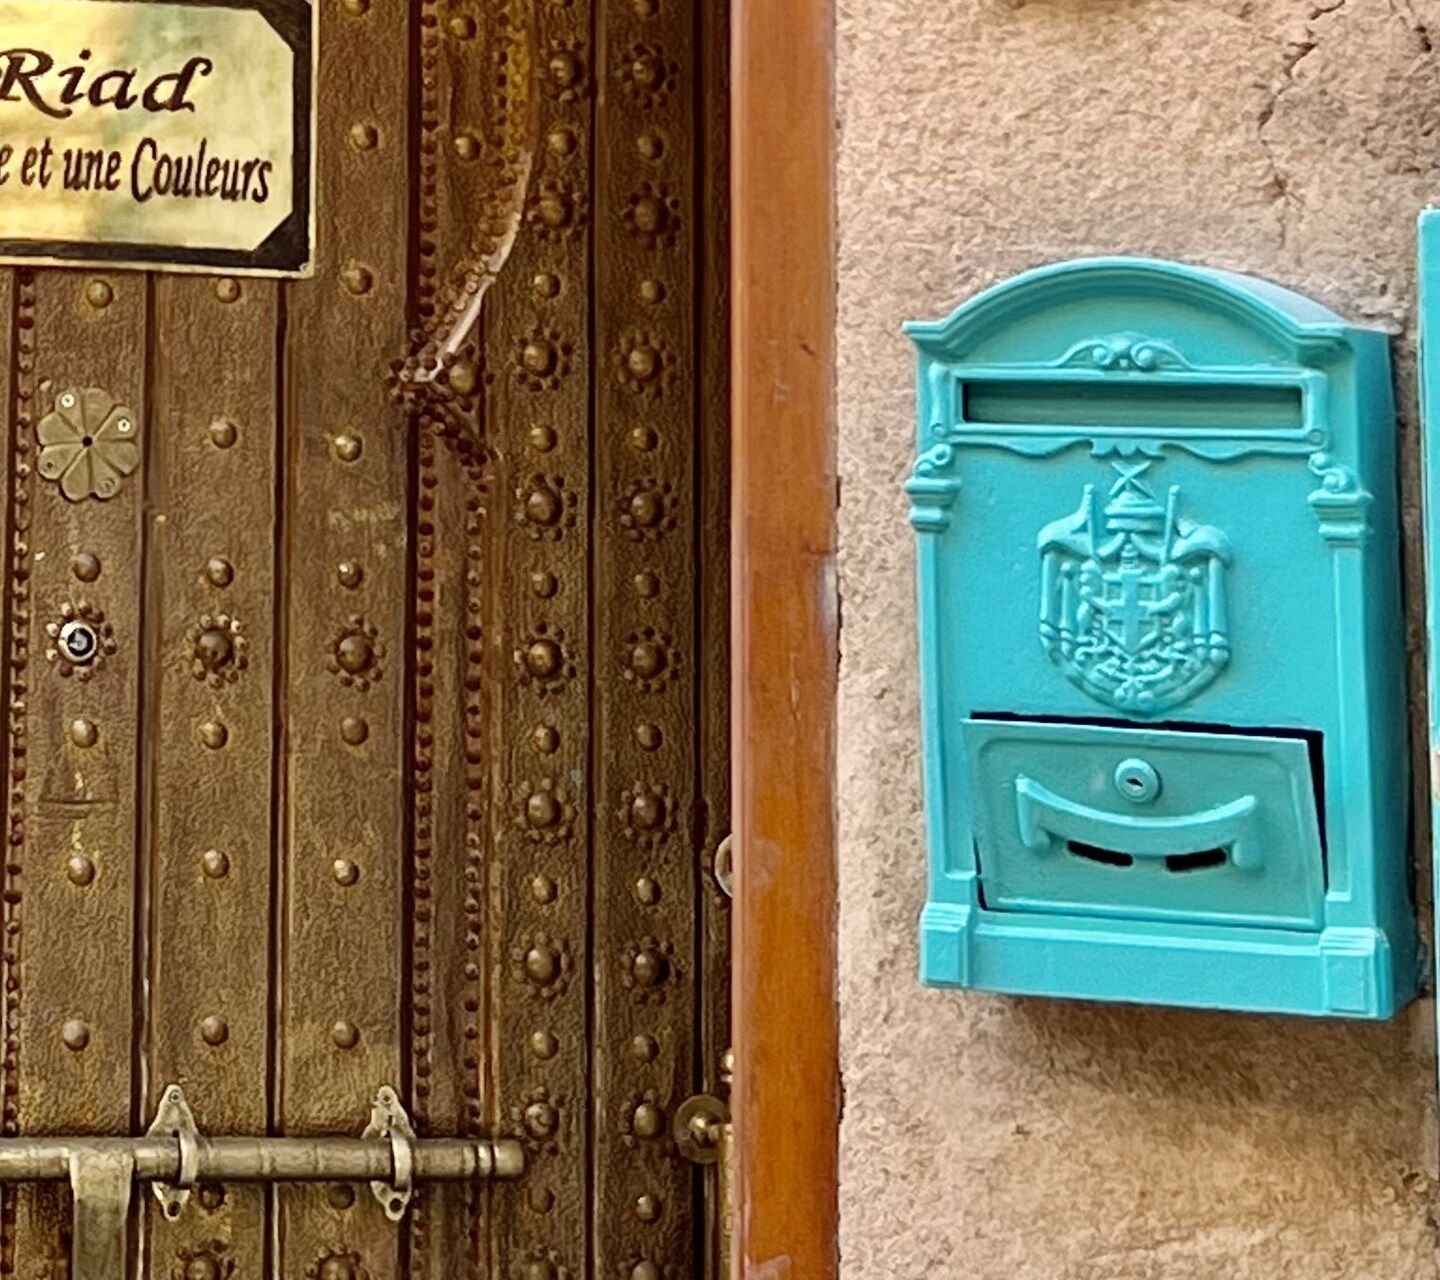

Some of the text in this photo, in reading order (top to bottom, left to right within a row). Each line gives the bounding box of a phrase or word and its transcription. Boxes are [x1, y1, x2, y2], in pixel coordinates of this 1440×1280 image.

[19, 137, 54, 190] et
[62, 146, 122, 193] une
[130, 136, 273, 205] Couleurs
